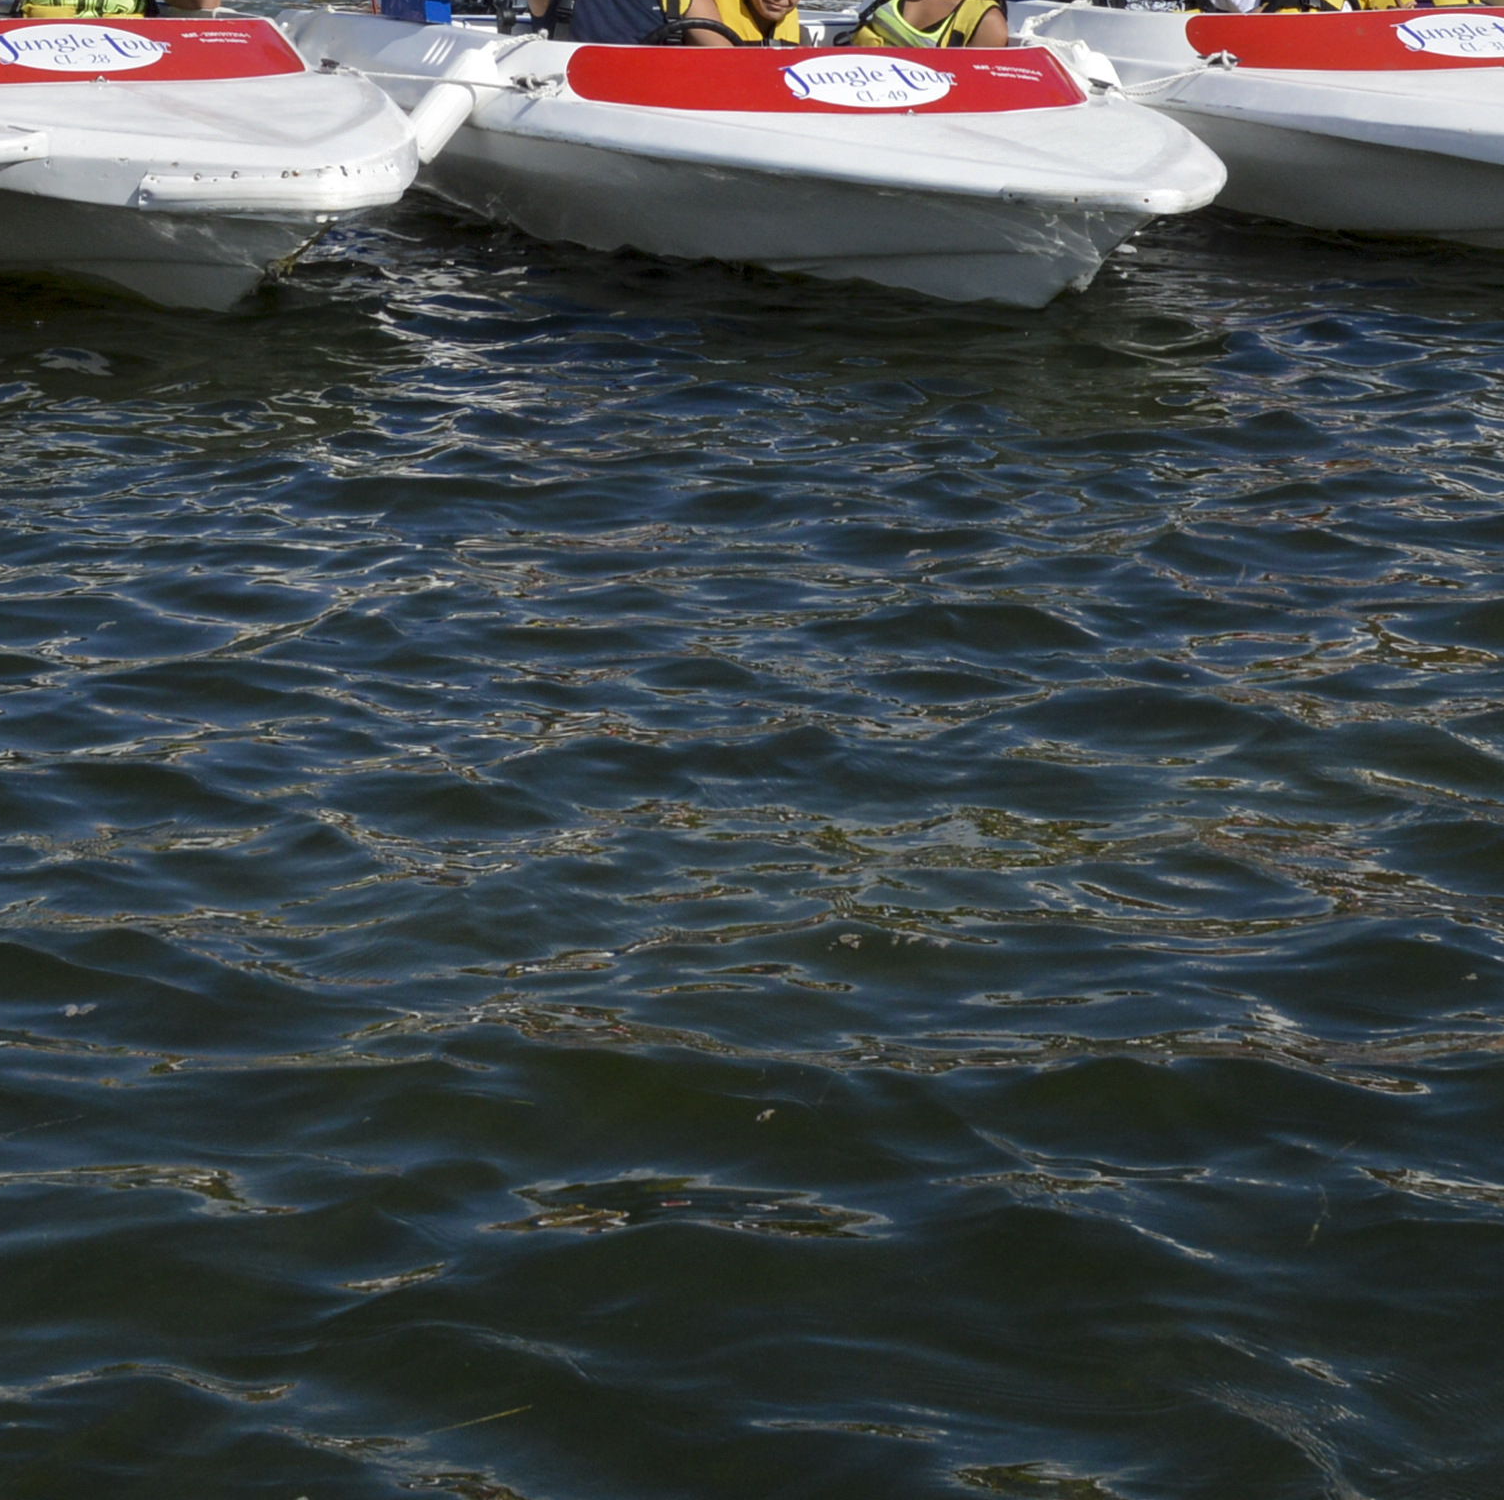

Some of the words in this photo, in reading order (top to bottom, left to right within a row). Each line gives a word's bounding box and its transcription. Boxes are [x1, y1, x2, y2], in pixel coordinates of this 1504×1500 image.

[100, 33, 171, 59] tour
[1390, 22, 1491, 52] Jungle
[780, 65, 884, 100] Jungle
[889, 62, 958, 91] tour
